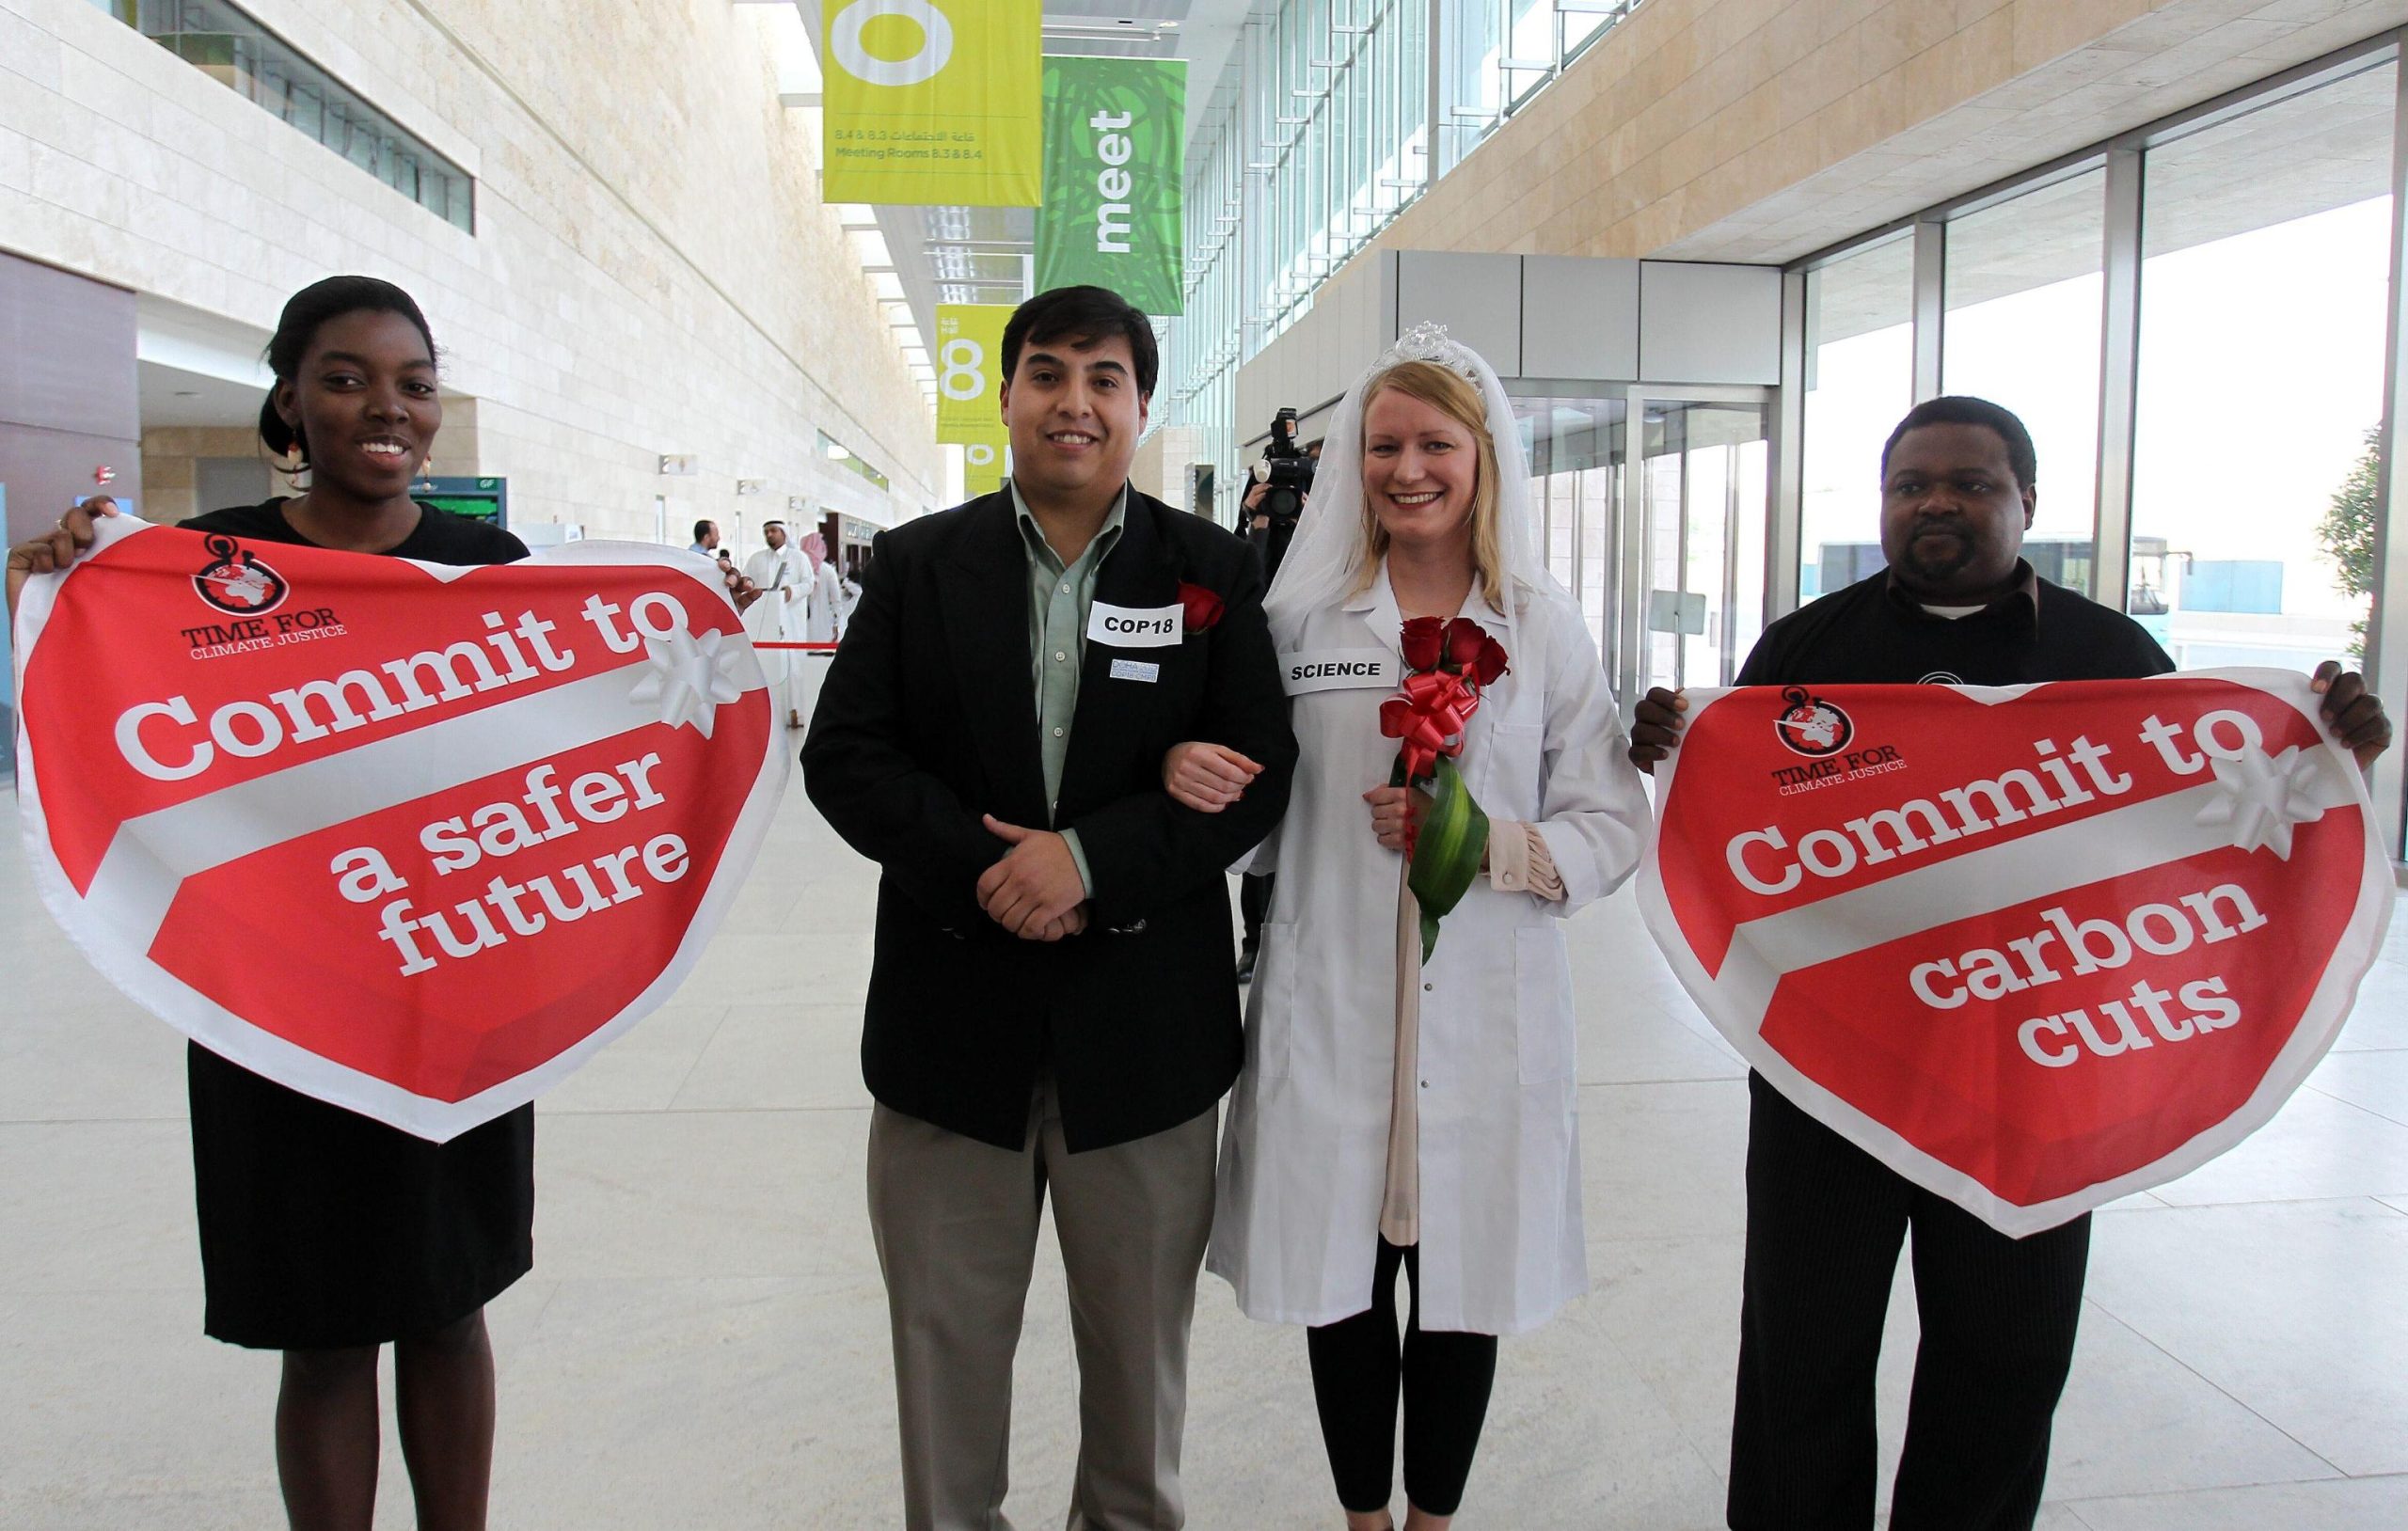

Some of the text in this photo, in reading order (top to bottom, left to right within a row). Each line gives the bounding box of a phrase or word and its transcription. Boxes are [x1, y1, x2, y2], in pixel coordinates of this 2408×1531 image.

[834, 130, 853, 140] 8.4
[835, 148, 982, 159] Meeting Rooms 8.3 & 8.4
[856, 130, 864, 140] &
[867, 130, 887, 141] 8.3
[1090, 110, 1132, 253] meet
[940, 338, 985, 401] 8
[181, 608, 341, 648] TIME FOR
[190, 624, 348, 660] CLIMATE JUSTICE
[1104, 617, 1174, 635] COP18
[115, 592, 689, 781] Commit to
[1291, 662, 1382, 681] SCIENCE
[1771, 745, 1902, 786] TIME FOR
[1780, 759, 1908, 797] CLIMATE JUSTICE
[1727, 709, 2263, 894] Commit to
[331, 752, 665, 902] a safer
[378, 834, 689, 976] future
[1910, 884, 2267, 1008] carbon
[2018, 976, 2241, 1066] cuts
